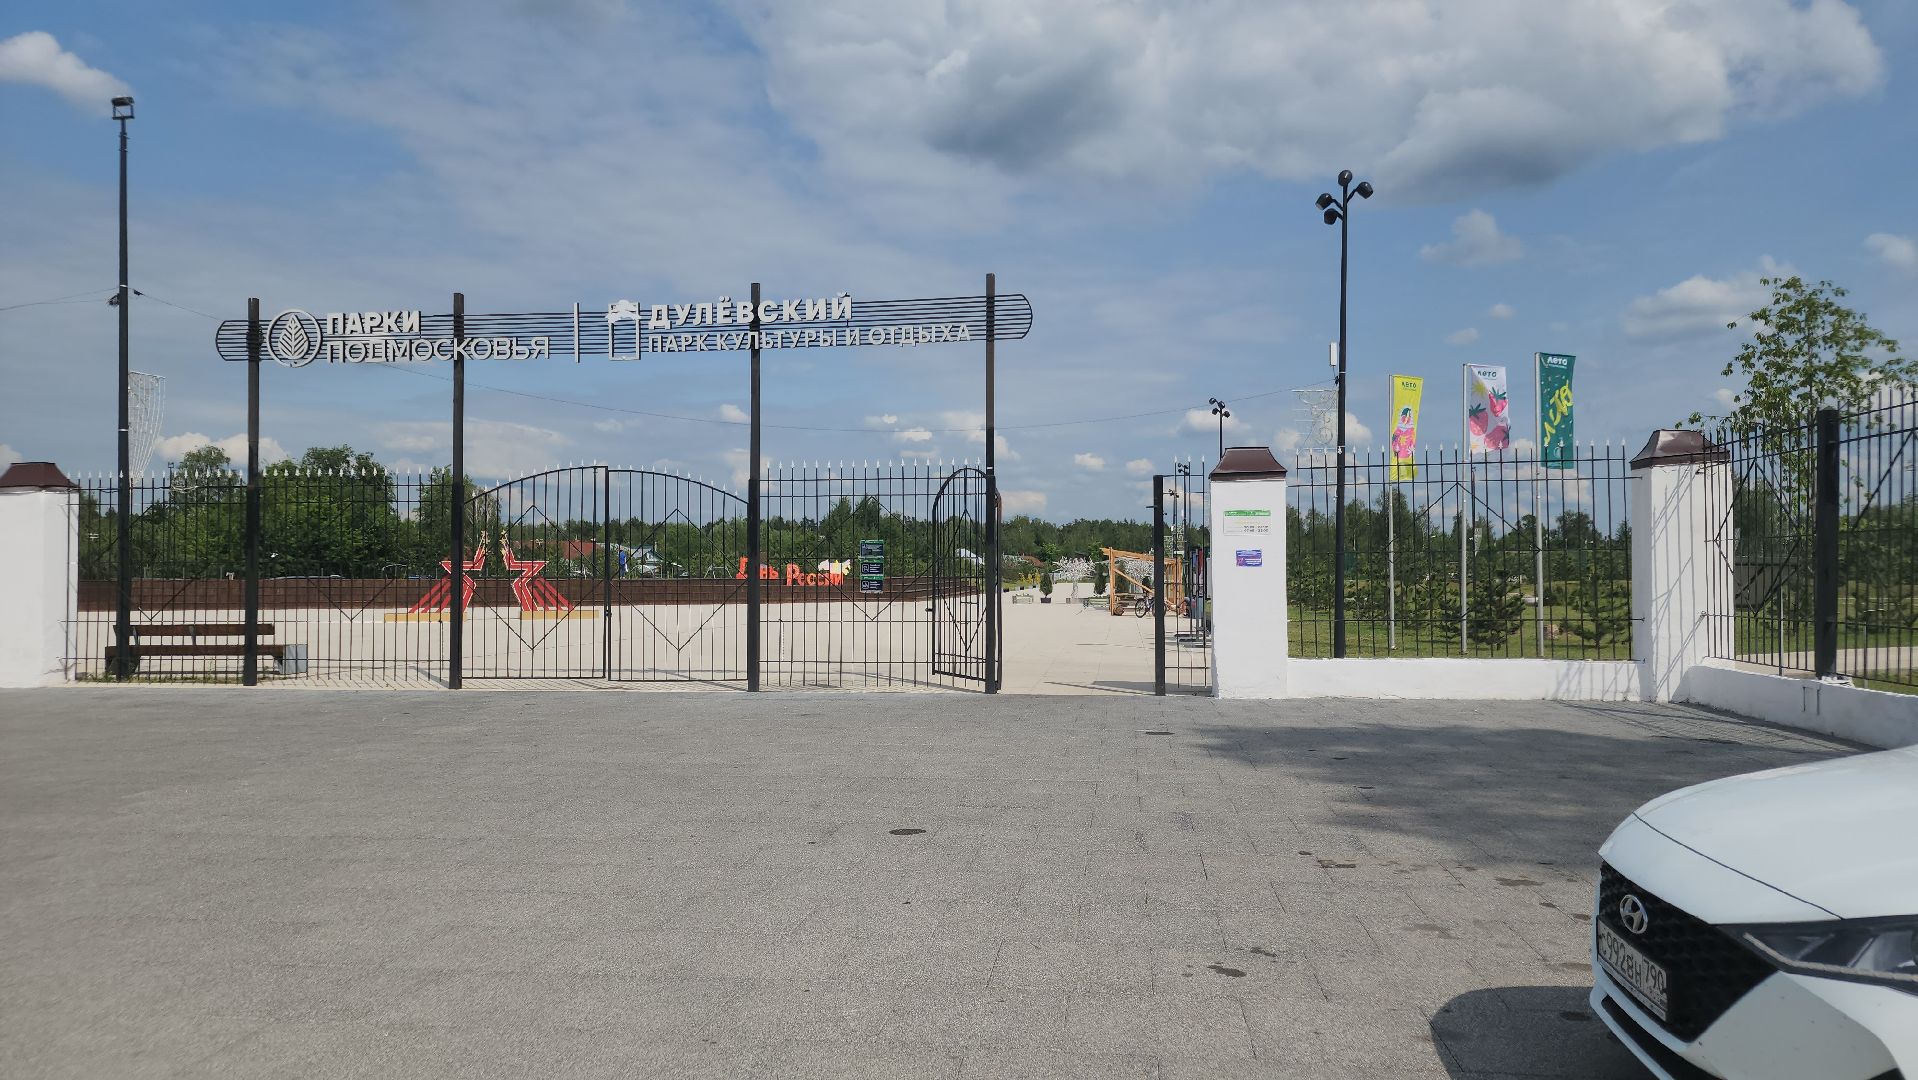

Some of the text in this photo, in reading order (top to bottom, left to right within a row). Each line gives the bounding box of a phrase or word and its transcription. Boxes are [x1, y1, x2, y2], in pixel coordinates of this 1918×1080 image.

[326, 310, 421, 335] ПАРКИ
[648, 290, 852, 330] ДУЛЁВСКИЙ
[326, 336, 549, 363] ПОДМОСКОВЬЯ
[648, 323, 971, 353] ПАРК КУЛЬТУРЫ И ОТДЫХА
